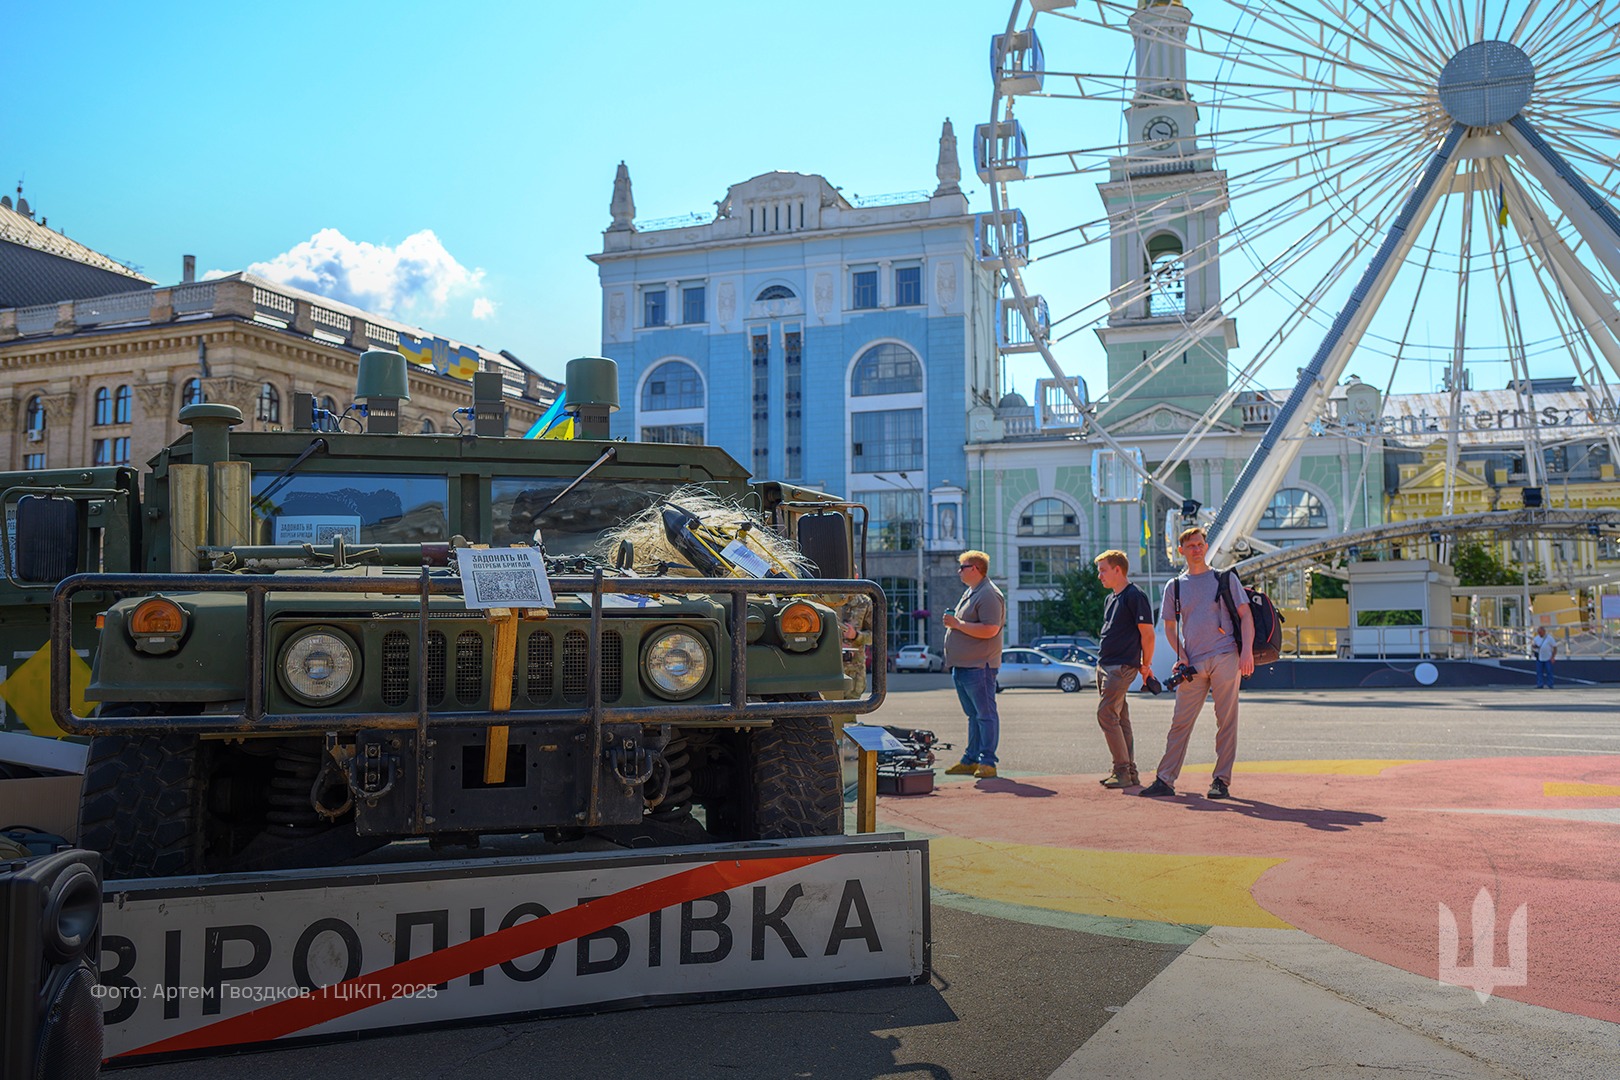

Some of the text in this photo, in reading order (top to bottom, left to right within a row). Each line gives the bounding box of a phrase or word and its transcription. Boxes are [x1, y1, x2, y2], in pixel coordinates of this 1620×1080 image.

[1461, 404, 1559, 430] ferrs
[472, 553, 529, 563] ЗАДОНАТЬ НА
